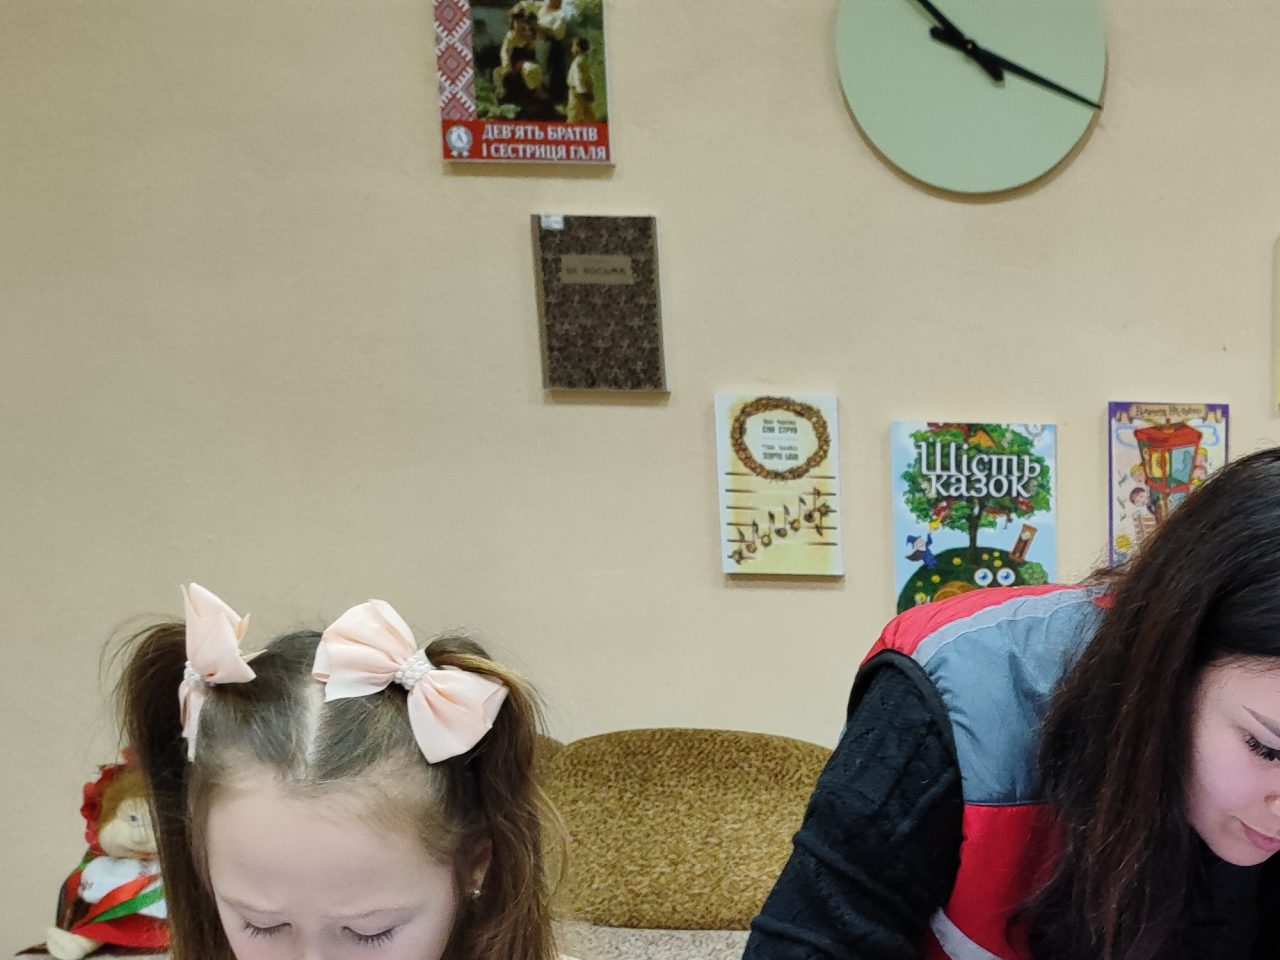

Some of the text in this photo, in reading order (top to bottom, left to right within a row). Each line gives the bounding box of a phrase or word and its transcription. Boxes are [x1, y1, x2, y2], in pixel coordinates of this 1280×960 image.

[482, 124, 598, 141] ДЕВ'ЯТЬ БРАТІВ
[490, 144, 566, 160] СЕСТРИЦЯ
[570, 145, 607, 160] ГАЛЯ
[918, 440, 1041, 477] Шість
[929, 474, 1034, 498] казок
